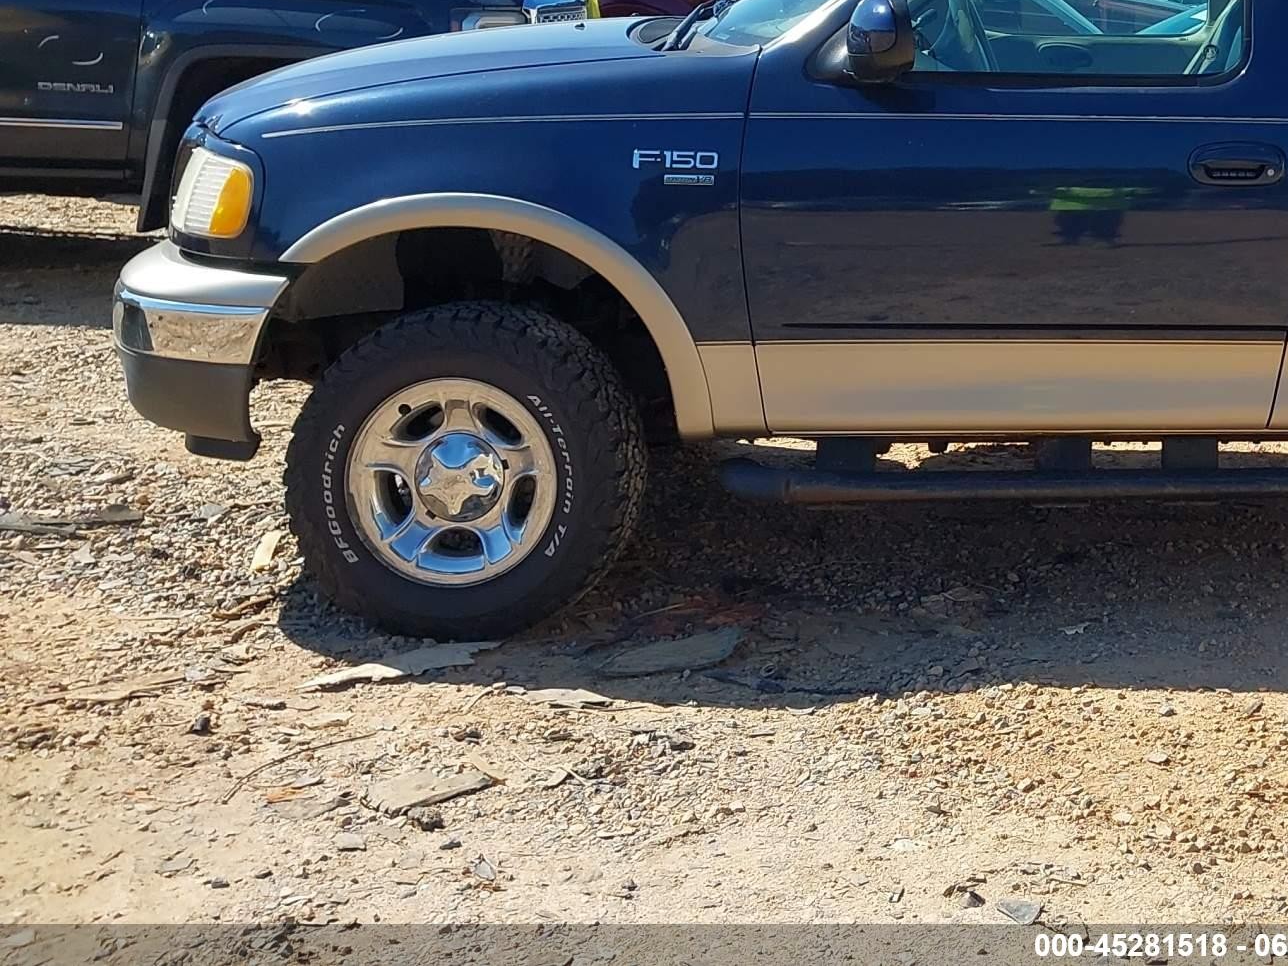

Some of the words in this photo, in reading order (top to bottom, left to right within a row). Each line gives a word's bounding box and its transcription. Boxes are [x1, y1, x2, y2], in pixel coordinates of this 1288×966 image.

[37, 81, 114, 94] DENALI
[632, 148, 719, 169] F-150
[527, 394, 575, 514] All-Terrain
[322, 423, 359, 564] BFGoodrich
[544, 522, 568, 558] T/A
